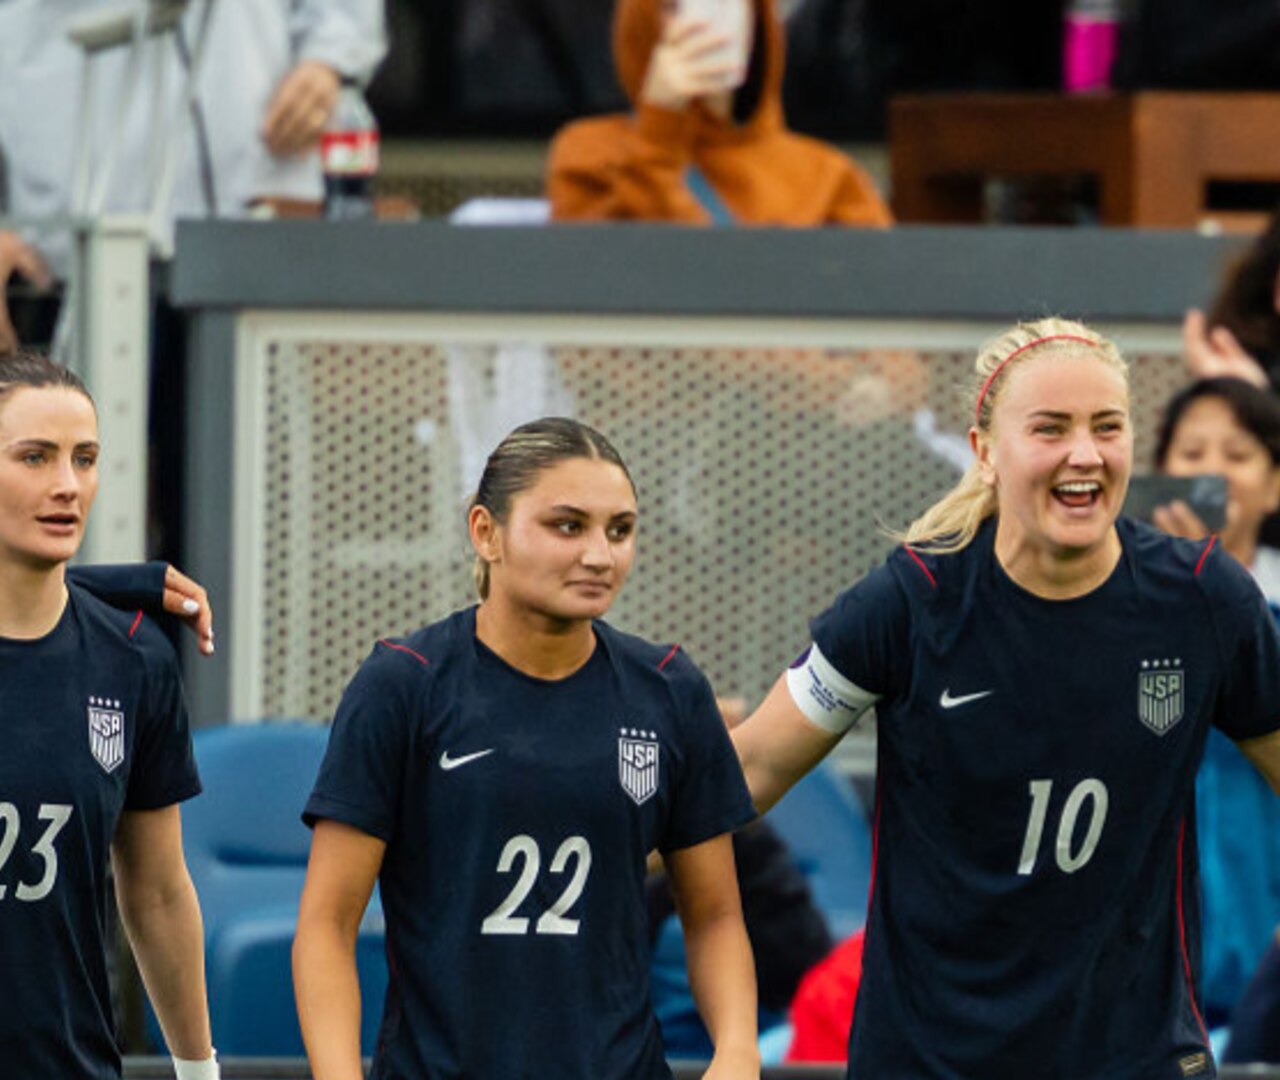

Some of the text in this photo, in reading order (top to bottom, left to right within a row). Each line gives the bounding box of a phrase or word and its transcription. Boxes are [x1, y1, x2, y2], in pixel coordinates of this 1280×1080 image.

[1142, 675, 1180, 700] USA
[90, 711, 120, 737] USA
[623, 742, 656, 769] USA
[1017, 778, 1108, 875] 10
[480, 834, 592, 936] 22
